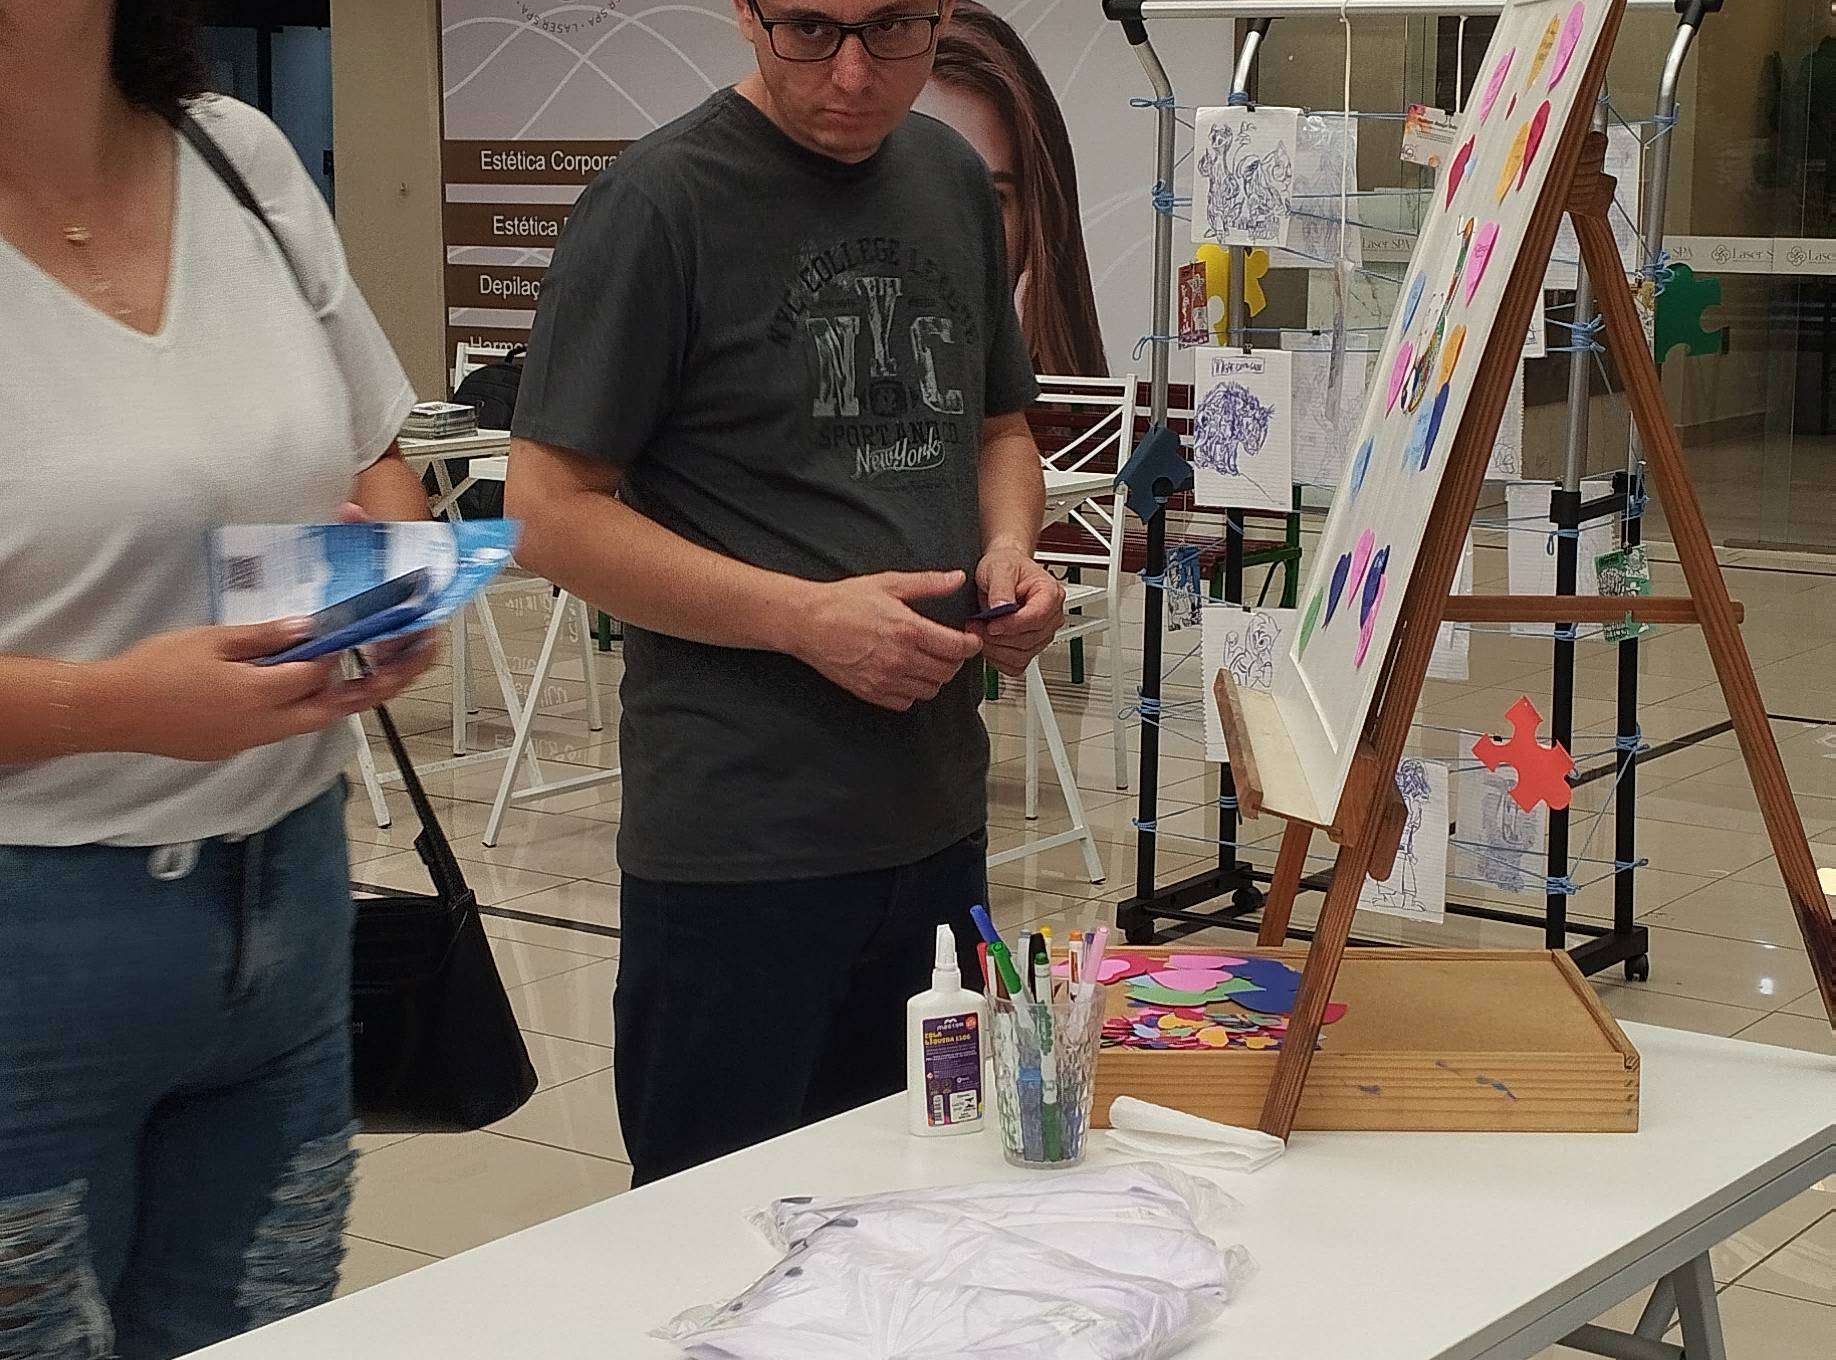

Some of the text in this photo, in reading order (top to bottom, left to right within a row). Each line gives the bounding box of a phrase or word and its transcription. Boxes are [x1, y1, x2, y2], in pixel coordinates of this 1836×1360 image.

[543, 21, 579, 34] LASER
[481, 150, 625, 175] Estética Corpora
[493, 216, 558, 236] Estética
[480, 274, 542, 301] Depilaç
[804, 276, 965, 416] NYC
